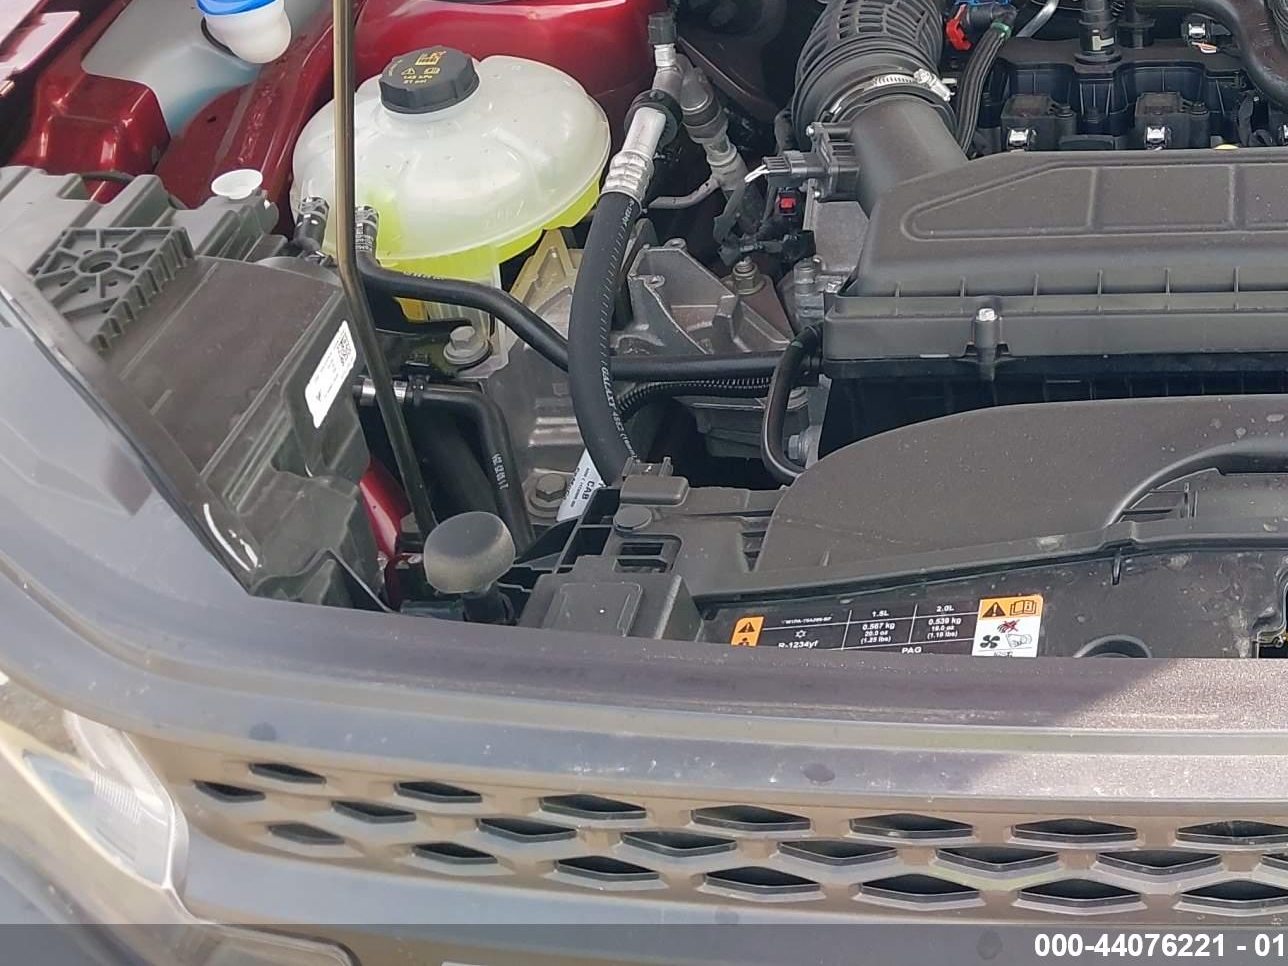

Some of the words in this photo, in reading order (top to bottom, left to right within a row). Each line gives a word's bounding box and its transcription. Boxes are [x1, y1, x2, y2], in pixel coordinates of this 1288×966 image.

[602, 366, 616, 411] GALAXY
[582, 480, 596, 501] CAB
[951, 617, 962, 625] kg
[885, 622, 895, 630] kg
[901, 646, 923, 654] PAG
